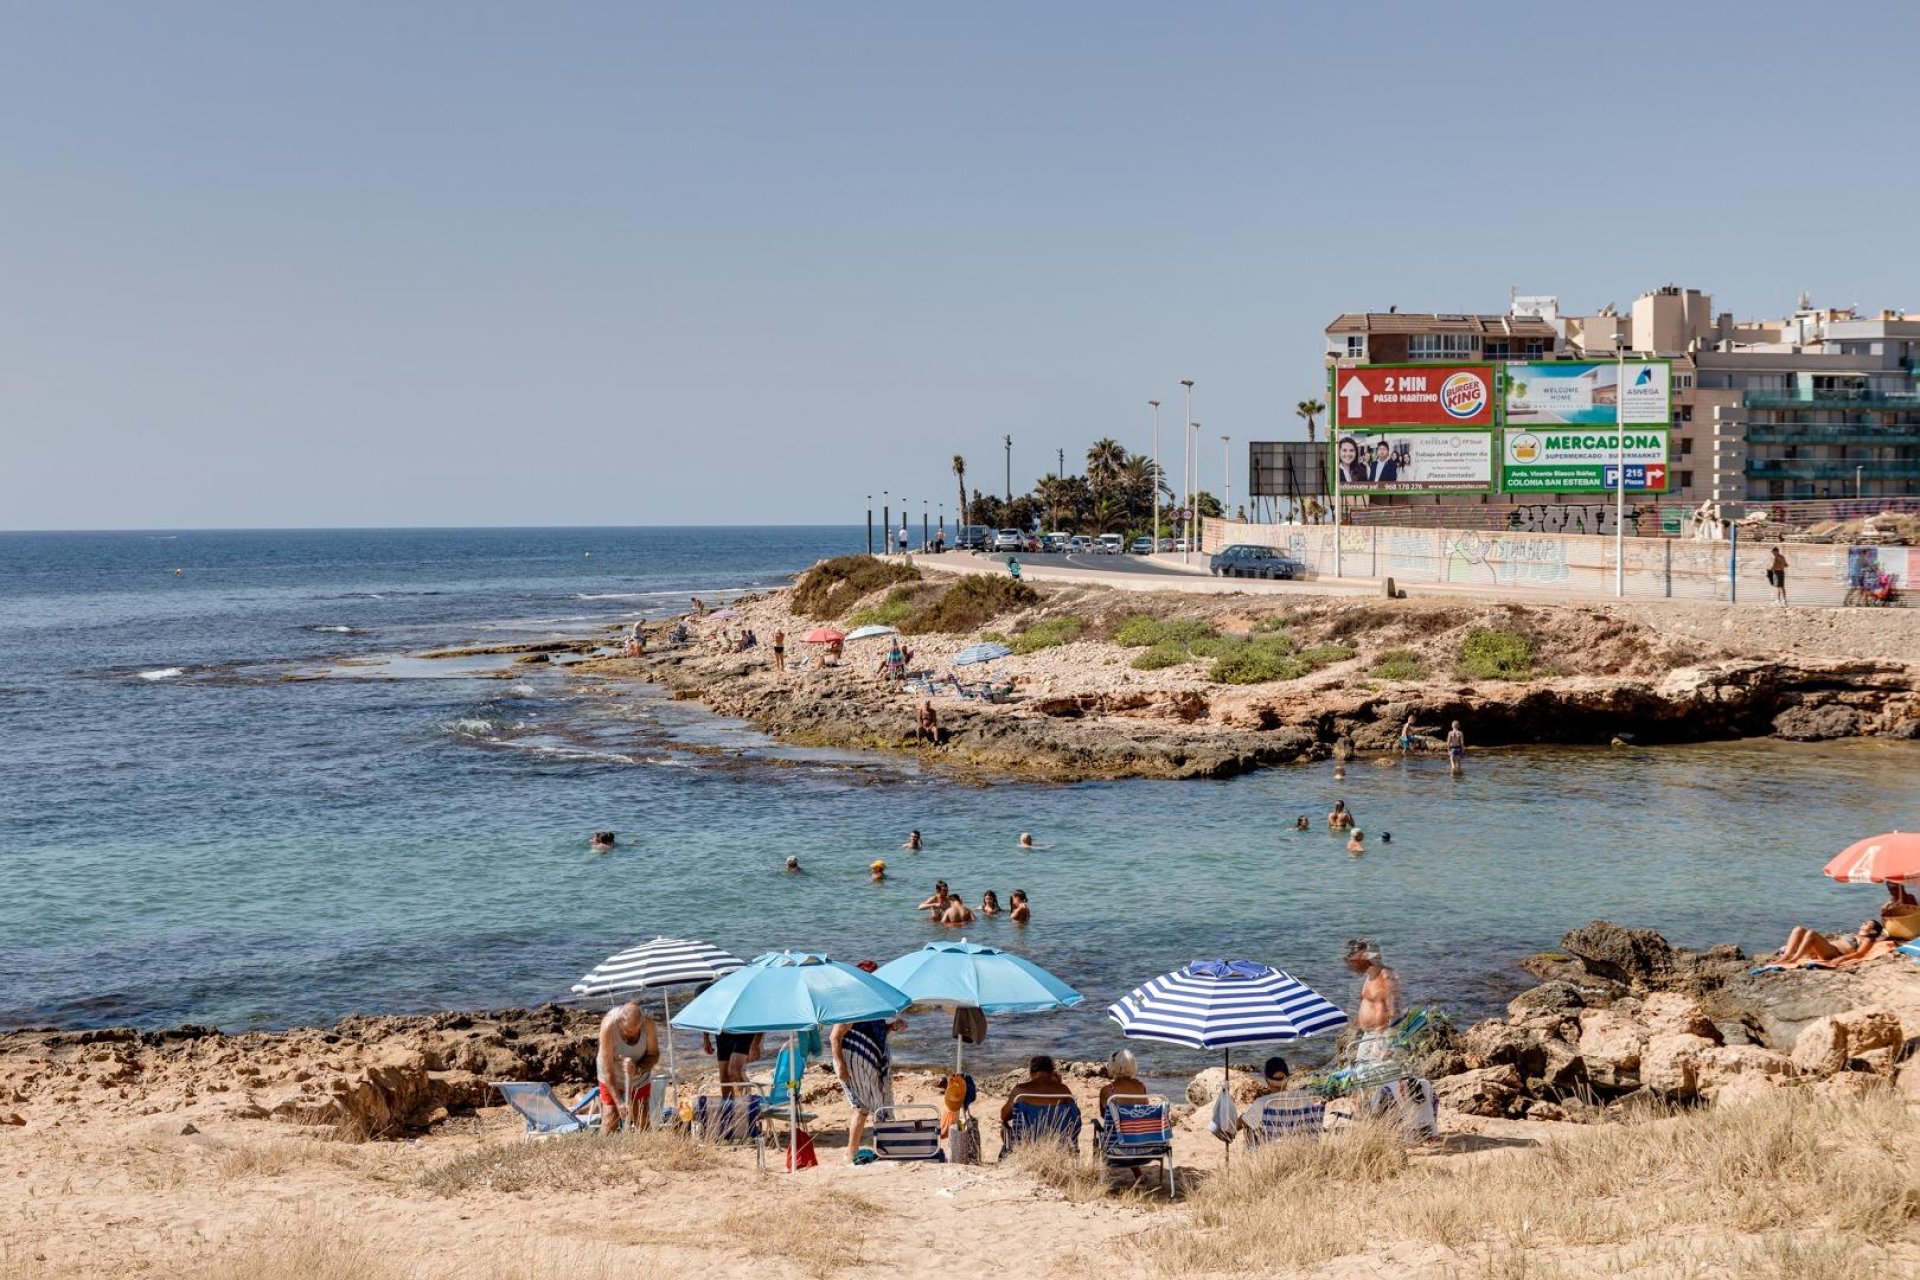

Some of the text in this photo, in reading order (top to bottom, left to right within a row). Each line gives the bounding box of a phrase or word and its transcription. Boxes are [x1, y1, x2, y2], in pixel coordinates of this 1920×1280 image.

[1384, 376, 1427, 392] 2 MIN
[1446, 381, 1480, 398] BURGER
[1373, 394, 1398, 403] PASEO
[1447, 390, 1481, 409] KING
[1545, 435, 1661, 450] MERCADONA
[1625, 469, 1643, 477] 215
[1563, 478, 1601, 486] ESTEBAN
[1624, 478, 1645, 486] Plazas
